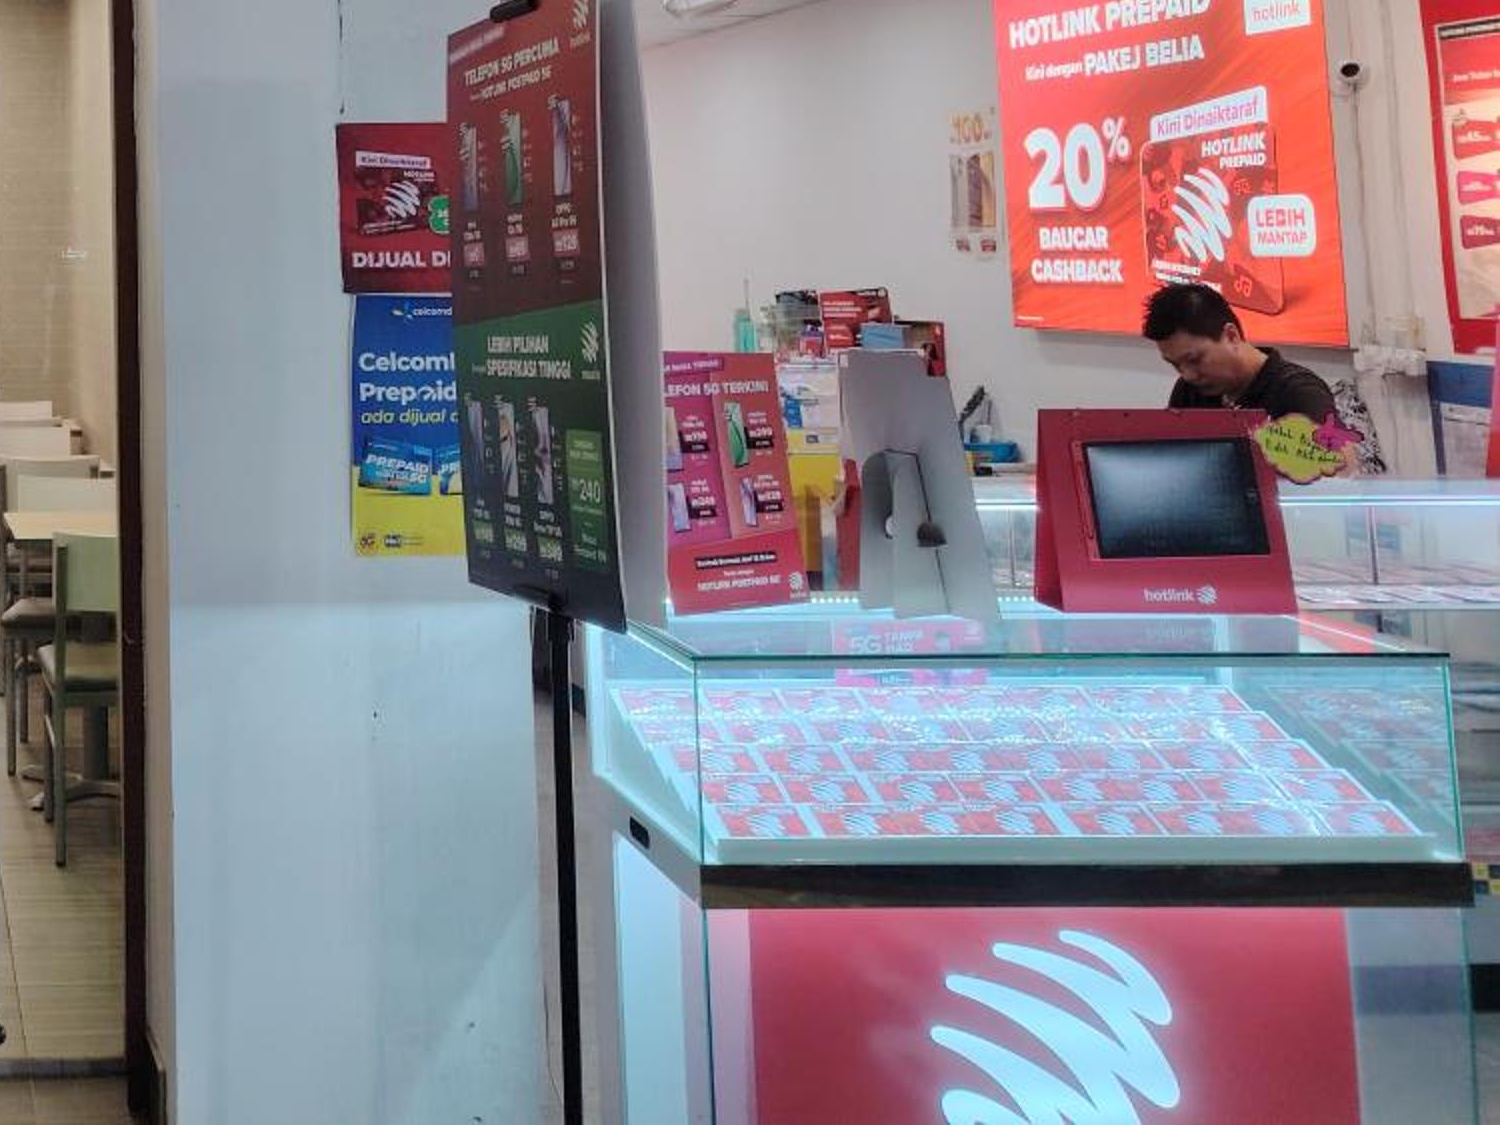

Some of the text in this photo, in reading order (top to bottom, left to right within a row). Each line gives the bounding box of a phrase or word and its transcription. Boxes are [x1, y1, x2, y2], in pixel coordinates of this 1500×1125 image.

[1009, 6, 1100, 49] HOTLINK
[1083, 46, 1141, 77] PAKEJ
[1145, 34, 1205, 68] BELIA
[1200, 130, 1267, 159] HOTLINK
[1218, 151, 1267, 170] PREPAID
[352, 251, 428, 269] DIJUAL
[1030, 258, 1125, 283] CASHBACK
